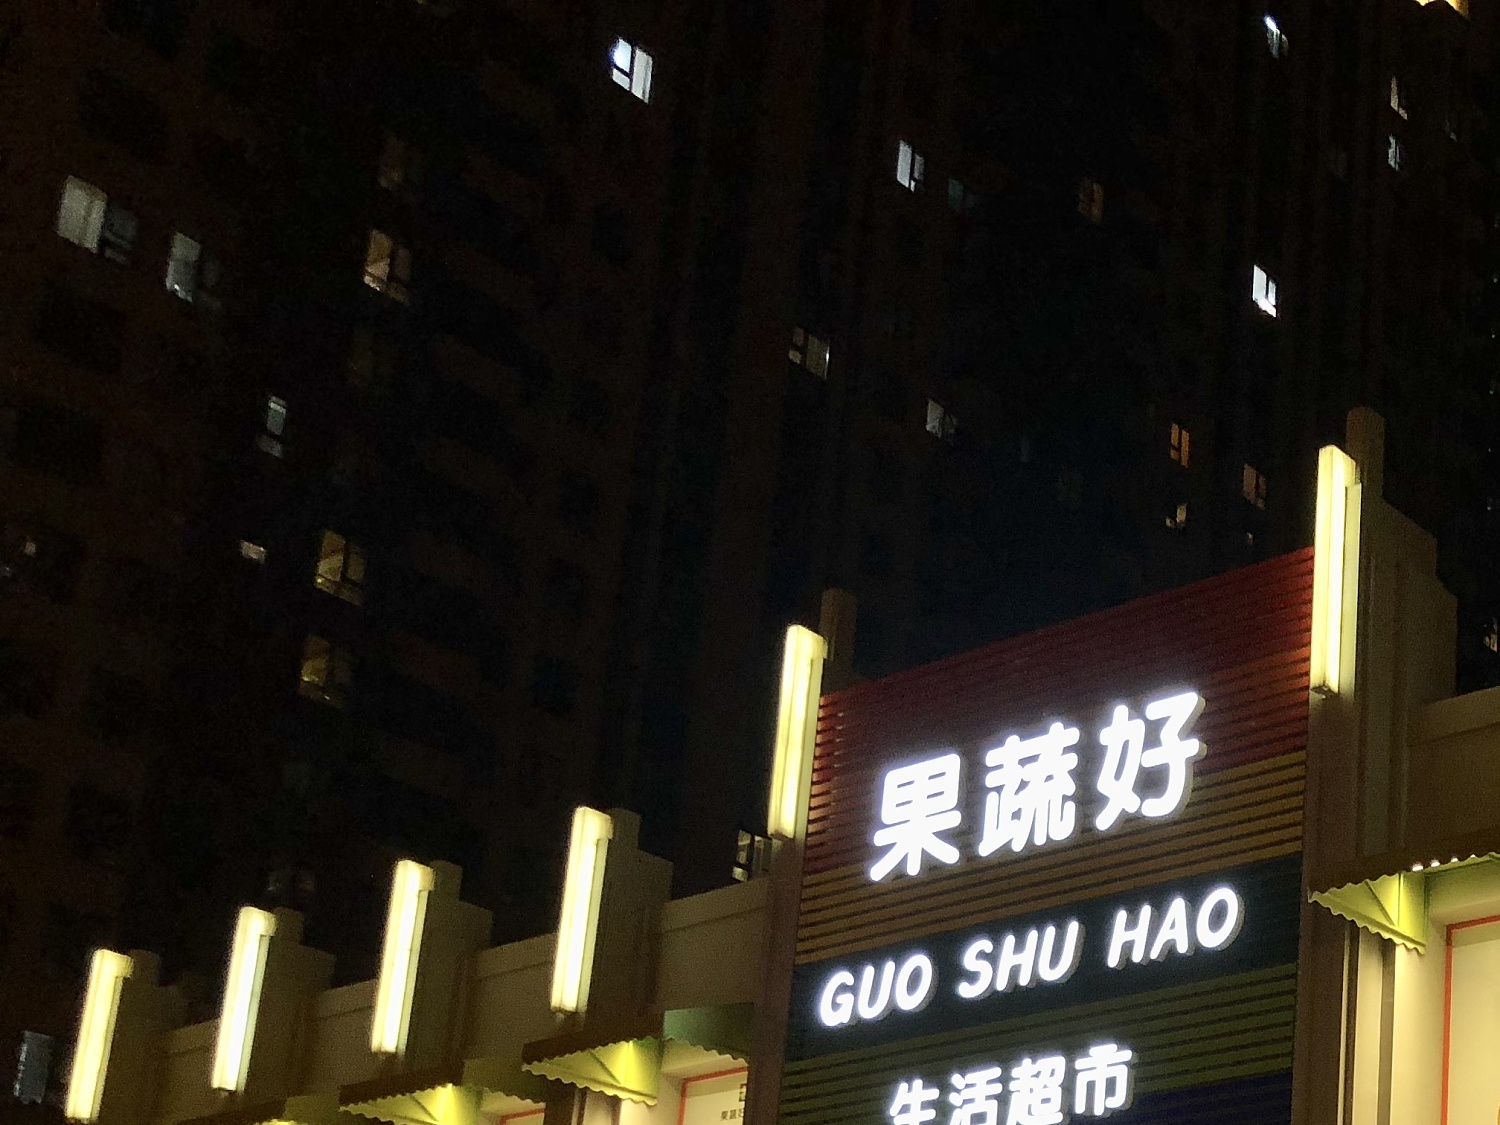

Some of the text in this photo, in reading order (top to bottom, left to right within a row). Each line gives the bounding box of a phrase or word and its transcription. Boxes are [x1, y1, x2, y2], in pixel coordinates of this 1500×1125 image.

[869, 691, 1202, 882] 果蔬好
[819, 886, 1241, 1027] GUO SHU HAO
